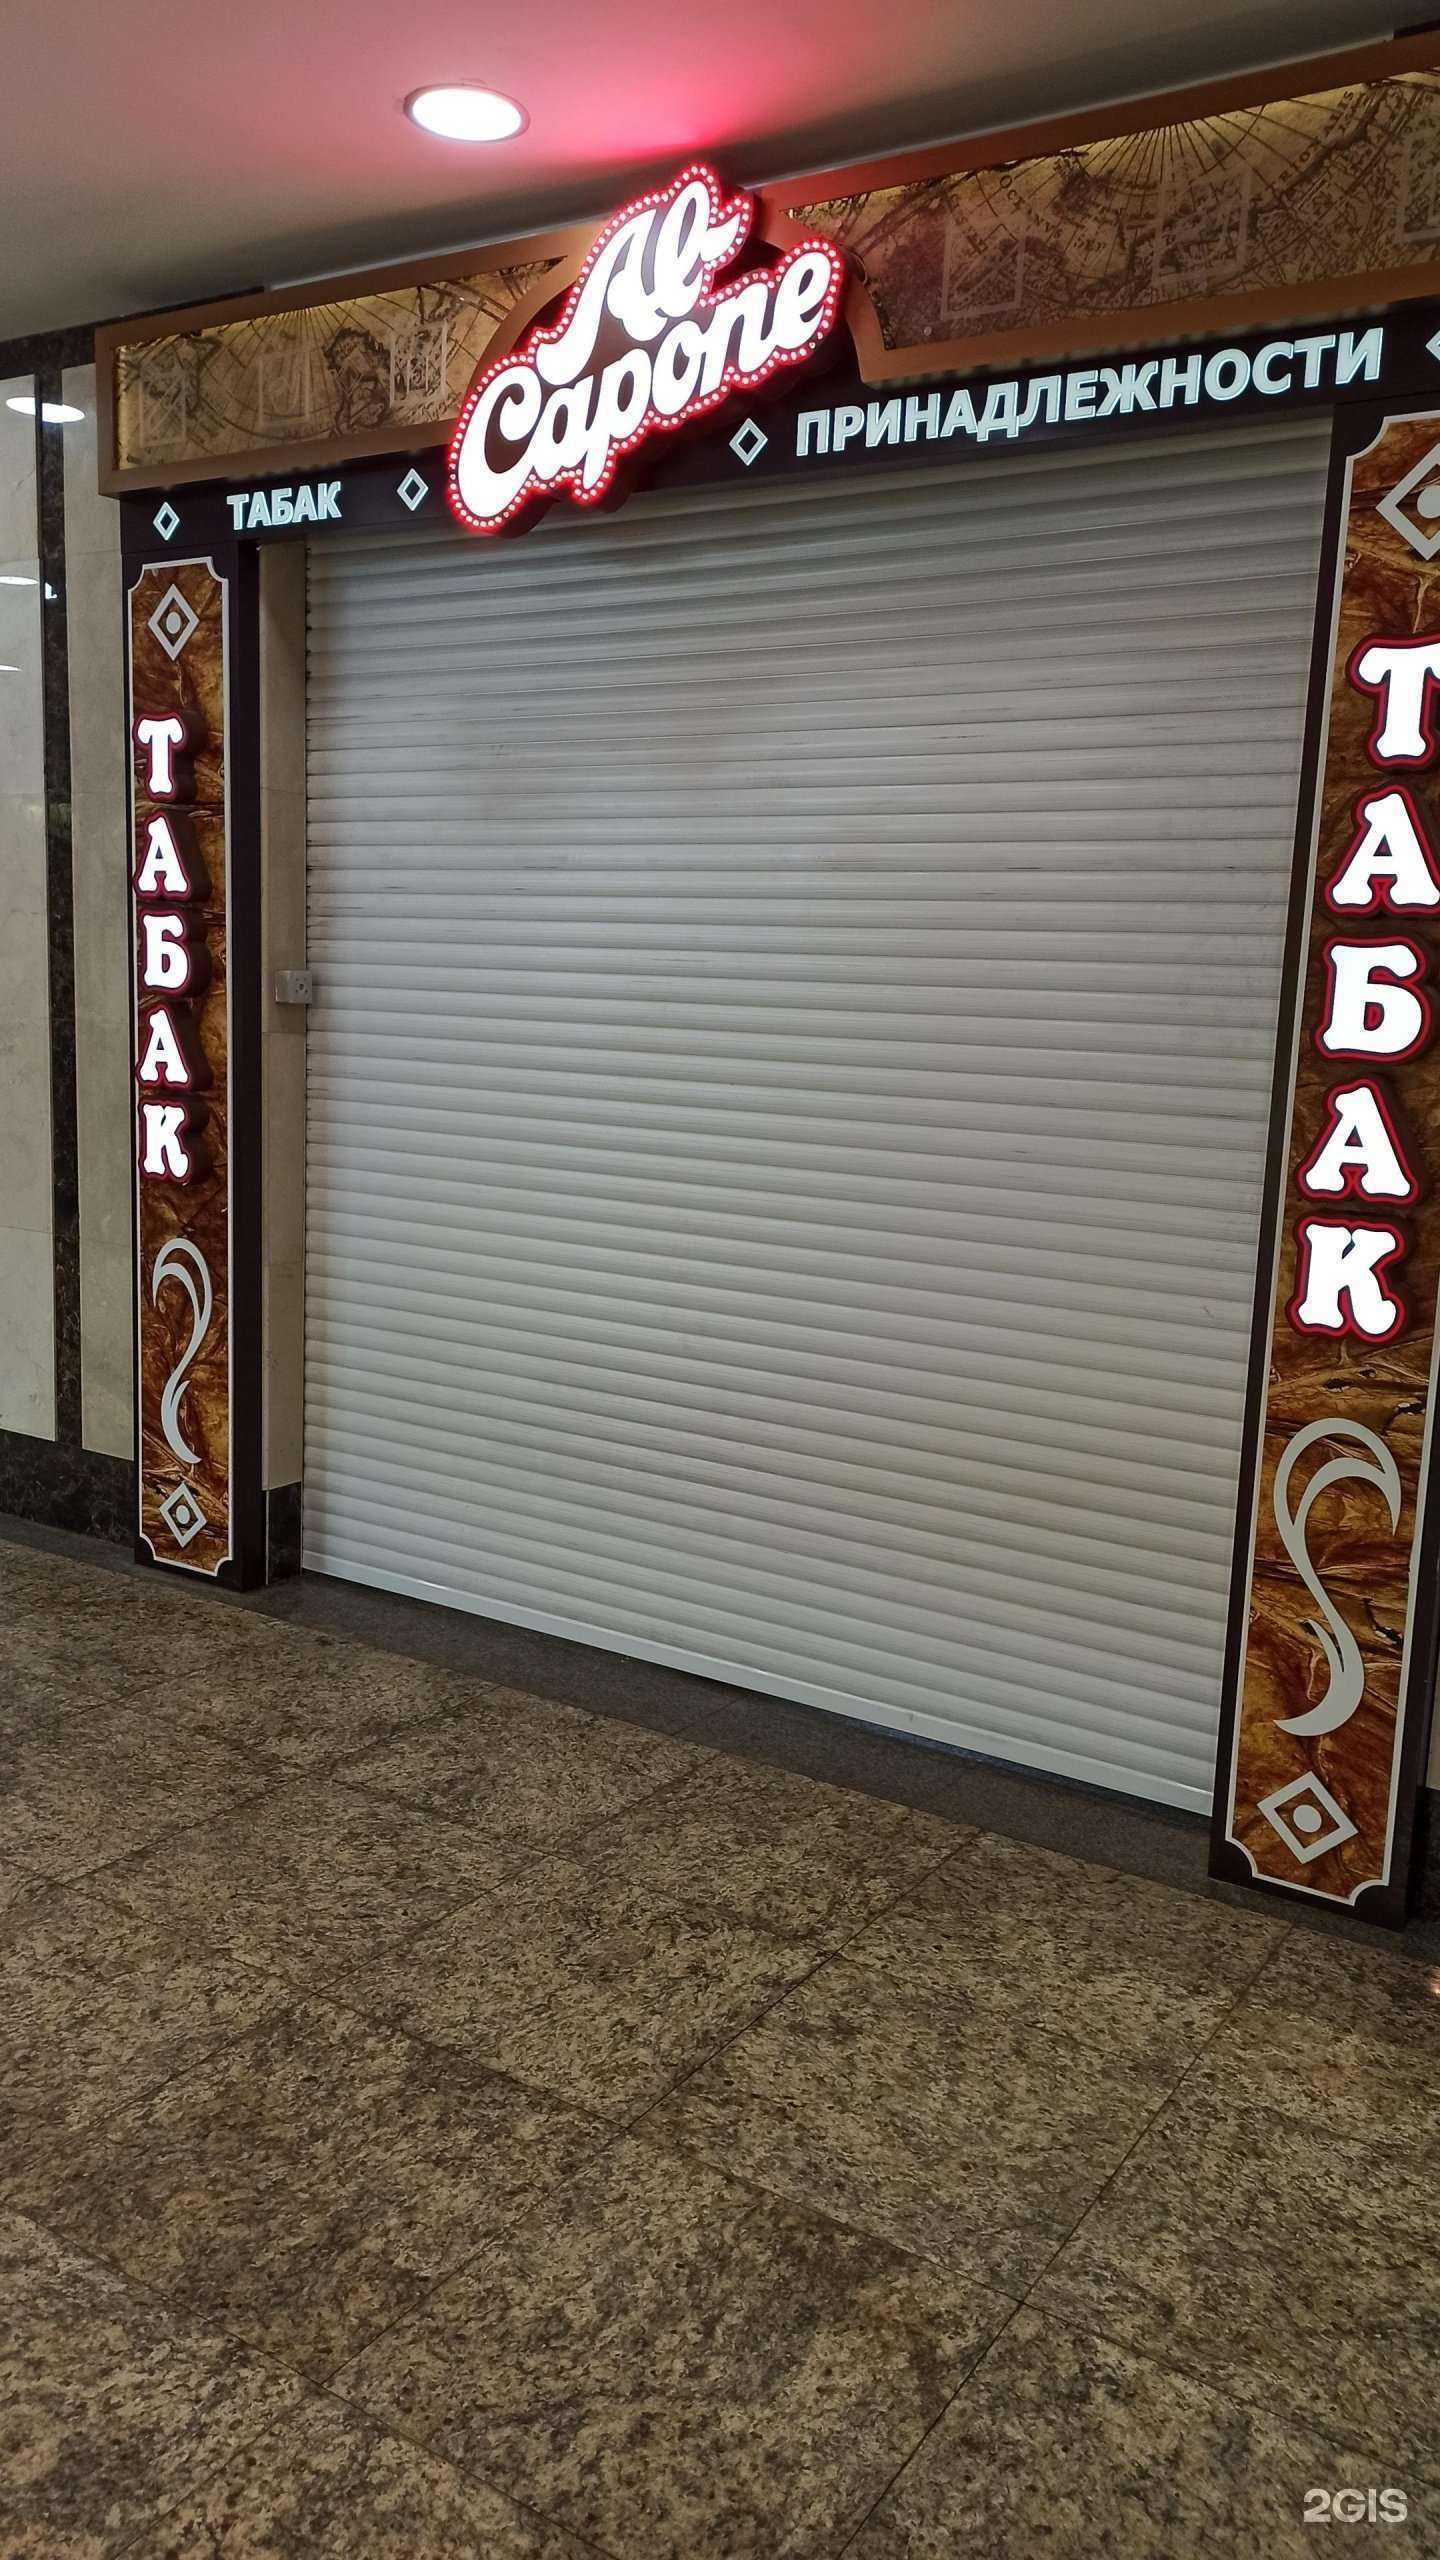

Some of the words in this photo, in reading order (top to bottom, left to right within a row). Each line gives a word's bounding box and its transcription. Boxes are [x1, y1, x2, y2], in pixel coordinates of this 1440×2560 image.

[457, 251, 832, 518] Capone
[536, 179, 742, 386] Al
[795, 326, 1385, 458] ПРИНАДЛЕЖНОСТИ
[226, 480, 342, 531] ТАБАК
[137, 716, 190, 1179] ТАБАК
[1298, 642, 1440, 1338] ТАБАК
